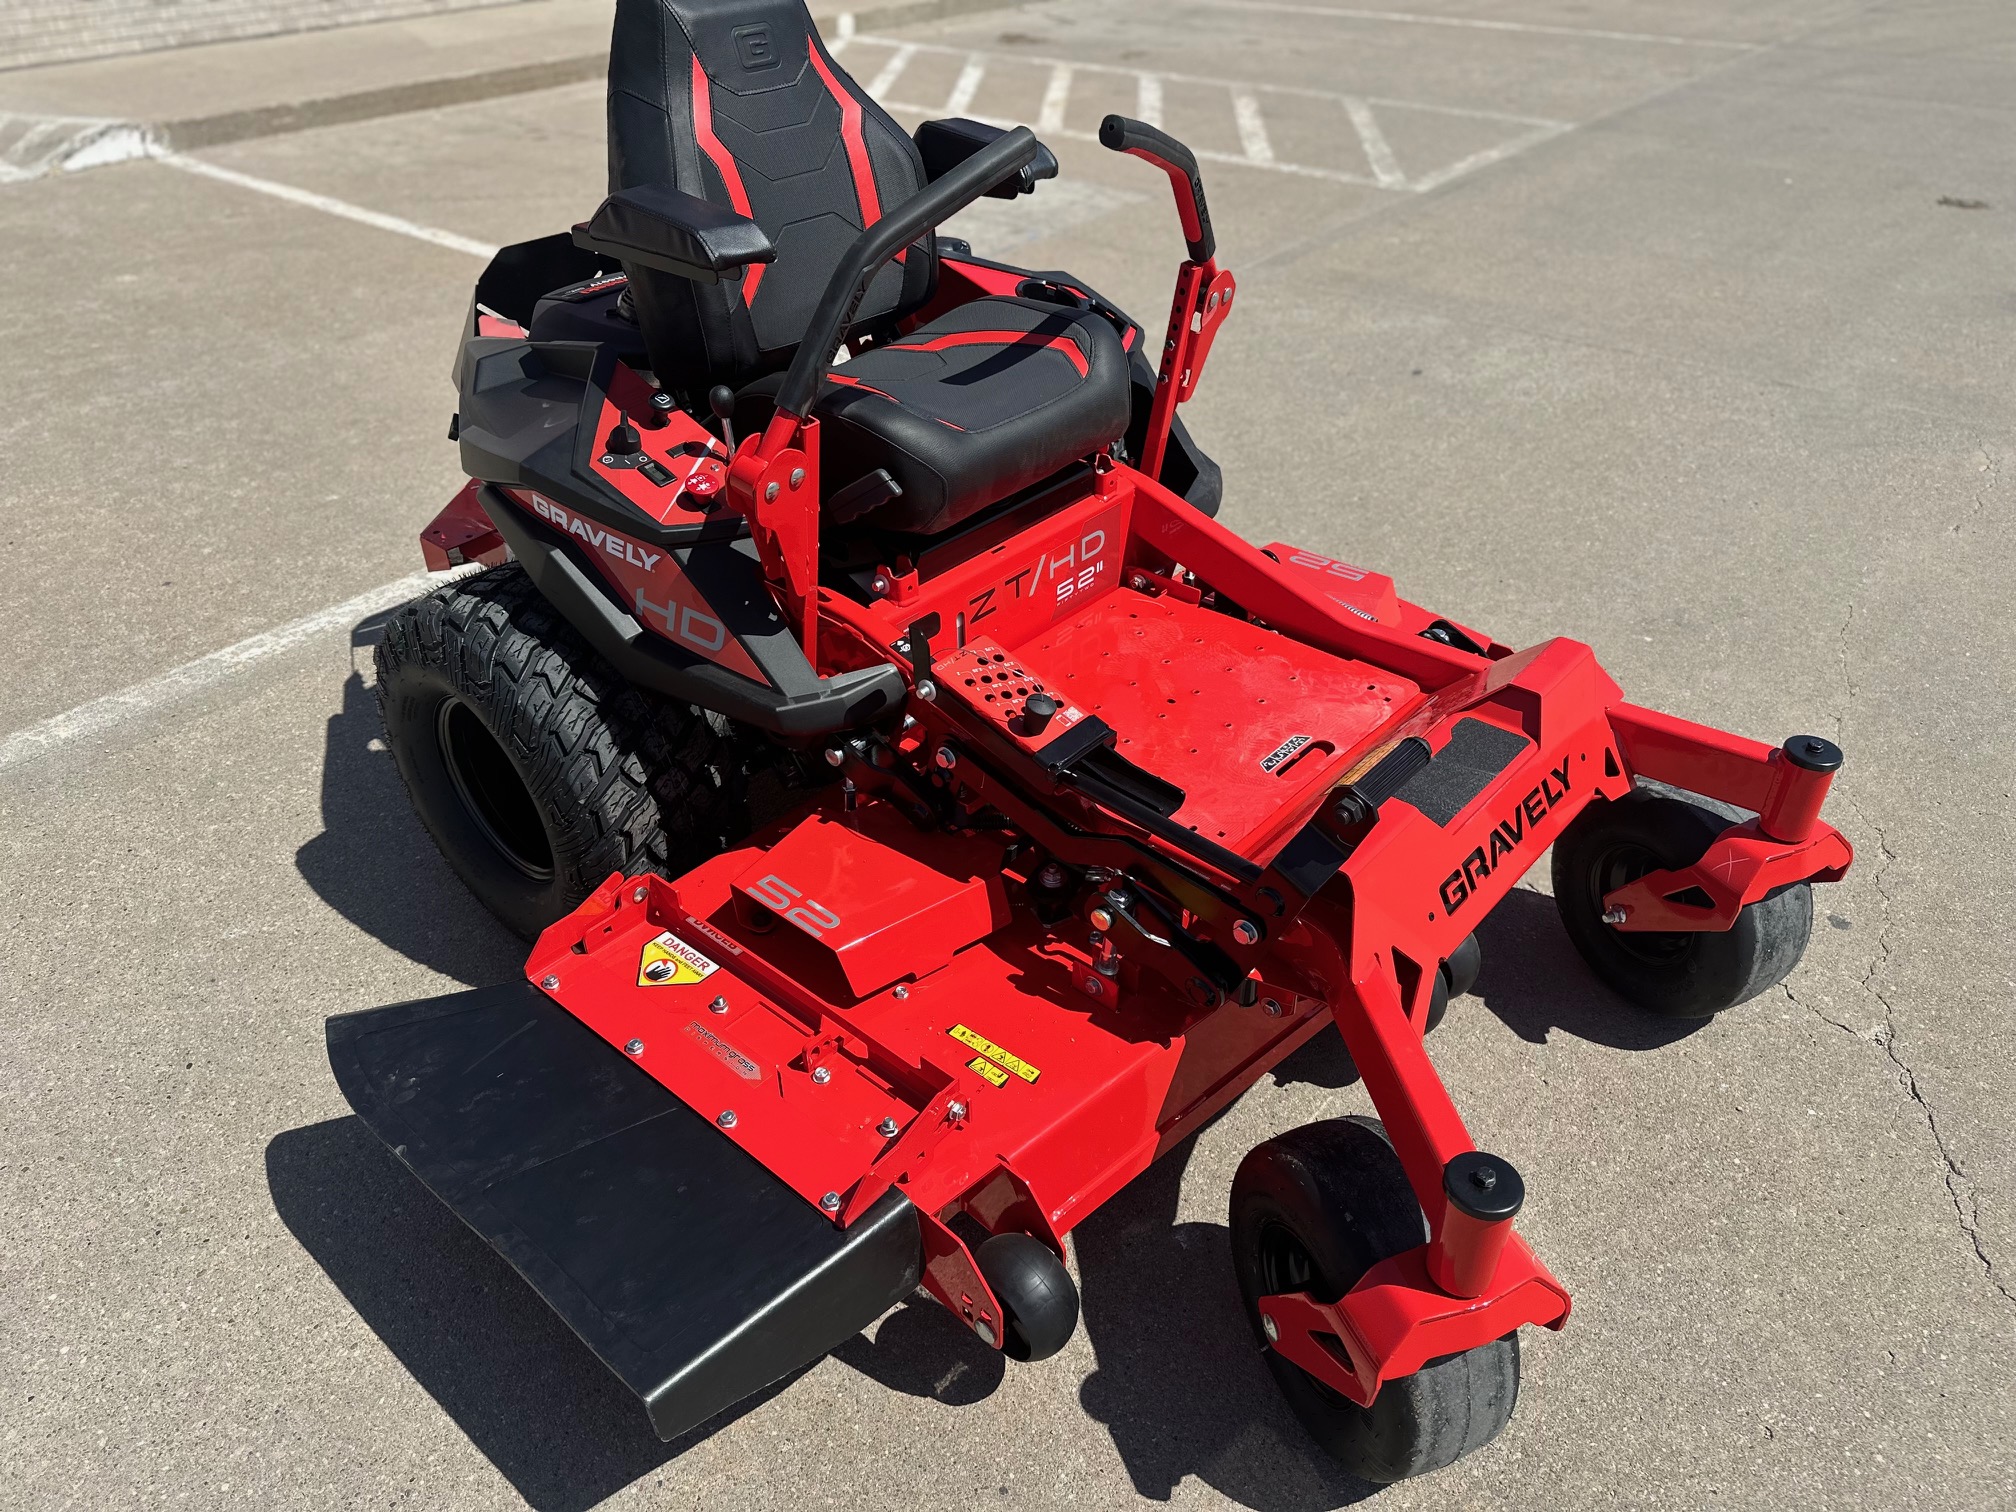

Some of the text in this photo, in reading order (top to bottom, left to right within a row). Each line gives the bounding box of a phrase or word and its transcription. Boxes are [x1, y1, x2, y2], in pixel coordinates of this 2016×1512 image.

[532, 494, 661, 572] GRAVELY
[1289, 551, 1370, 582] 52
[635, 587, 726, 651] HD
[1438, 753, 1572, 917] GRAVELY
[746, 874, 841, 938] 52
[652, 942, 664, 950] KEEP
[662, 948, 676, 960] HANDS
[682, 961, 694, 972] FEET
[662, 937, 711, 971] DANGER
